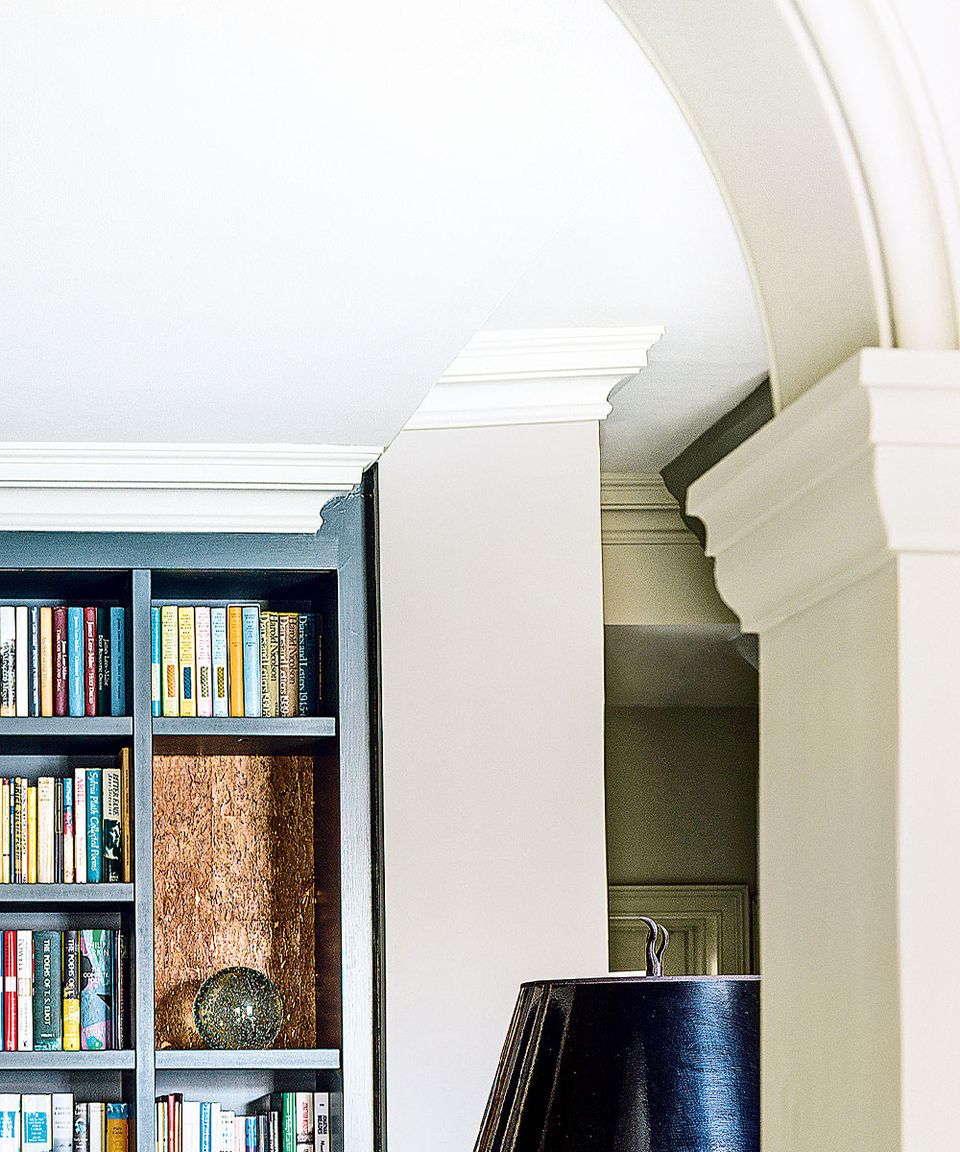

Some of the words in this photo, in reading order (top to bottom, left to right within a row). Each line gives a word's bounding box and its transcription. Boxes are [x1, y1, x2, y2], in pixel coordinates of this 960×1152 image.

[269, 613, 279, 644] Harold
[289, 616, 298, 646] Harold
[269, 645, 279, 682] Nicolson
[289, 647, 298, 685] Nicolson
[88, 771, 99, 795] Sylvia
[88, 796, 99, 815] Plath
[88, 816, 99, 848] Collected
[88, 849, 99, 872] Poems
[43, 939, 51, 953] THE
[43, 954, 51, 978] POEMS
[43, 978, 51, 989] OF
[43, 1005, 51, 1026] ELIOT
